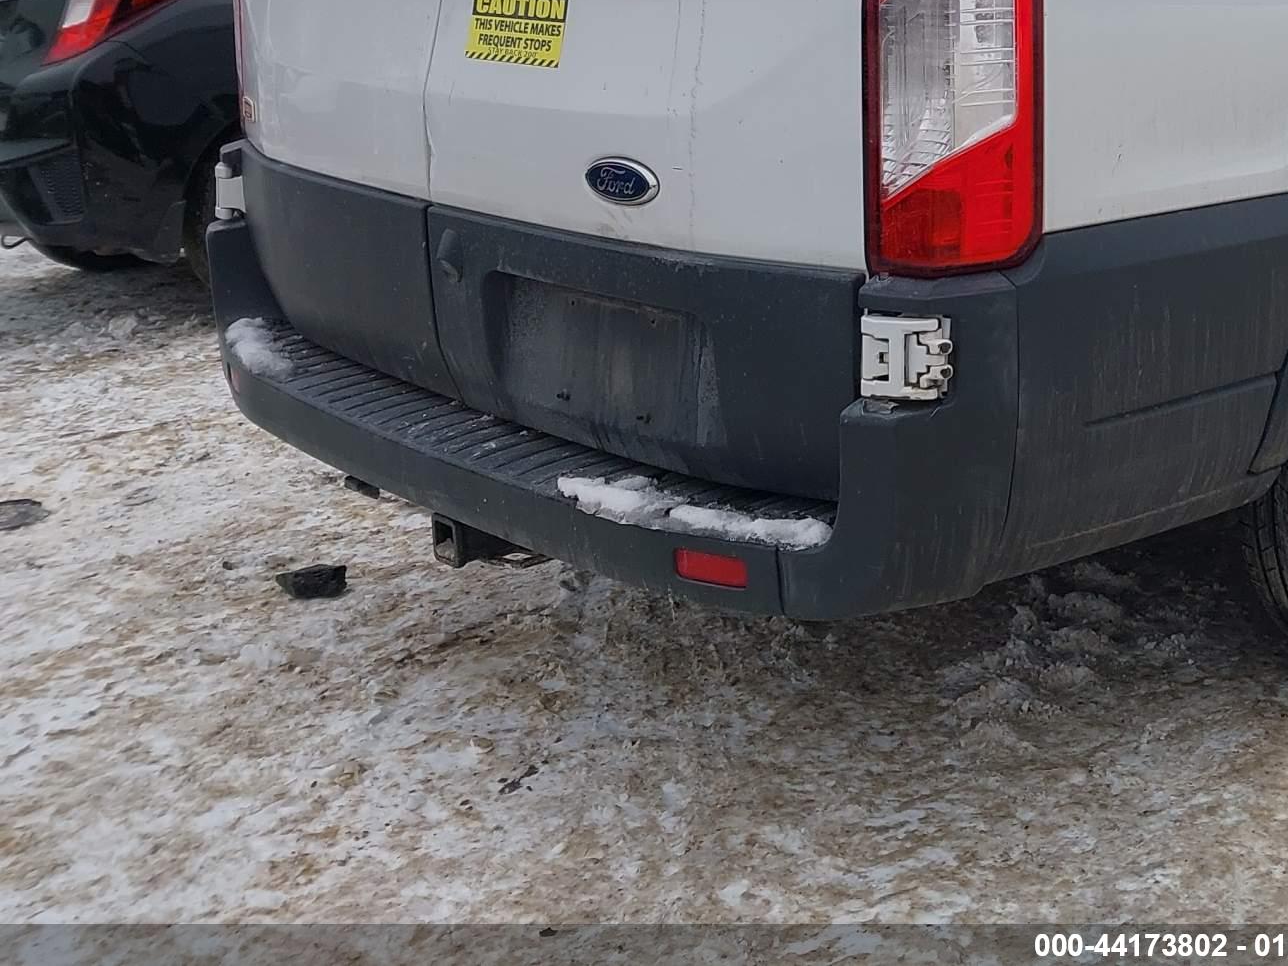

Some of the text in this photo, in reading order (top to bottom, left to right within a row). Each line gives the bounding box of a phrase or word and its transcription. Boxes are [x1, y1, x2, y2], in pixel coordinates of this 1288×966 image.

[474, 18, 562, 37] THIS VEHICLE MAKES
[478, 34, 552, 51] FREQUENT STOPS
[597, 167, 636, 194] Ford
